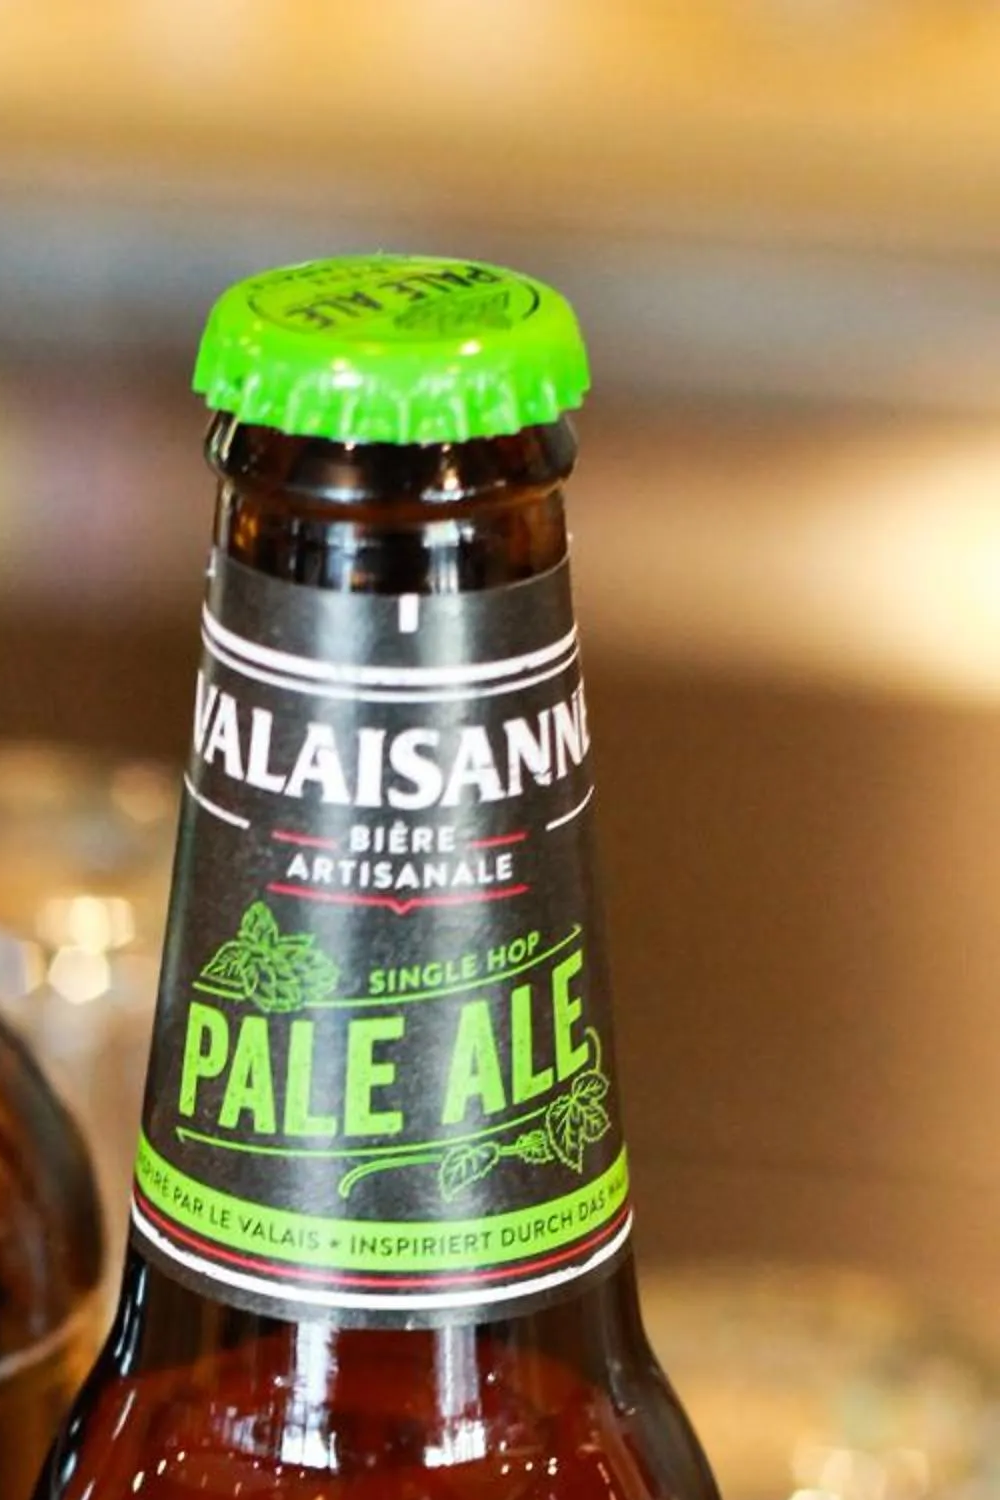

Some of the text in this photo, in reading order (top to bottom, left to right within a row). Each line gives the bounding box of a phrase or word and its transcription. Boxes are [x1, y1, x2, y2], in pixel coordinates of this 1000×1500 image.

[350, 822, 456, 854] BIÈRE
[286, 853, 514, 890] ARTISANALE
[368, 930, 540, 994] SINGLE HOP
[178, 950, 589, 1137] PALE ALE
[173, 1187, 203, 1216] PAR
[209, 1205, 231, 1230] LE
[238, 1214, 320, 1250] VALAIS
[350, 1231, 492, 1257] INSPIRIERT
[500, 1213, 574, 1247] DURCH
[578, 1190, 606, 1222] DAS
